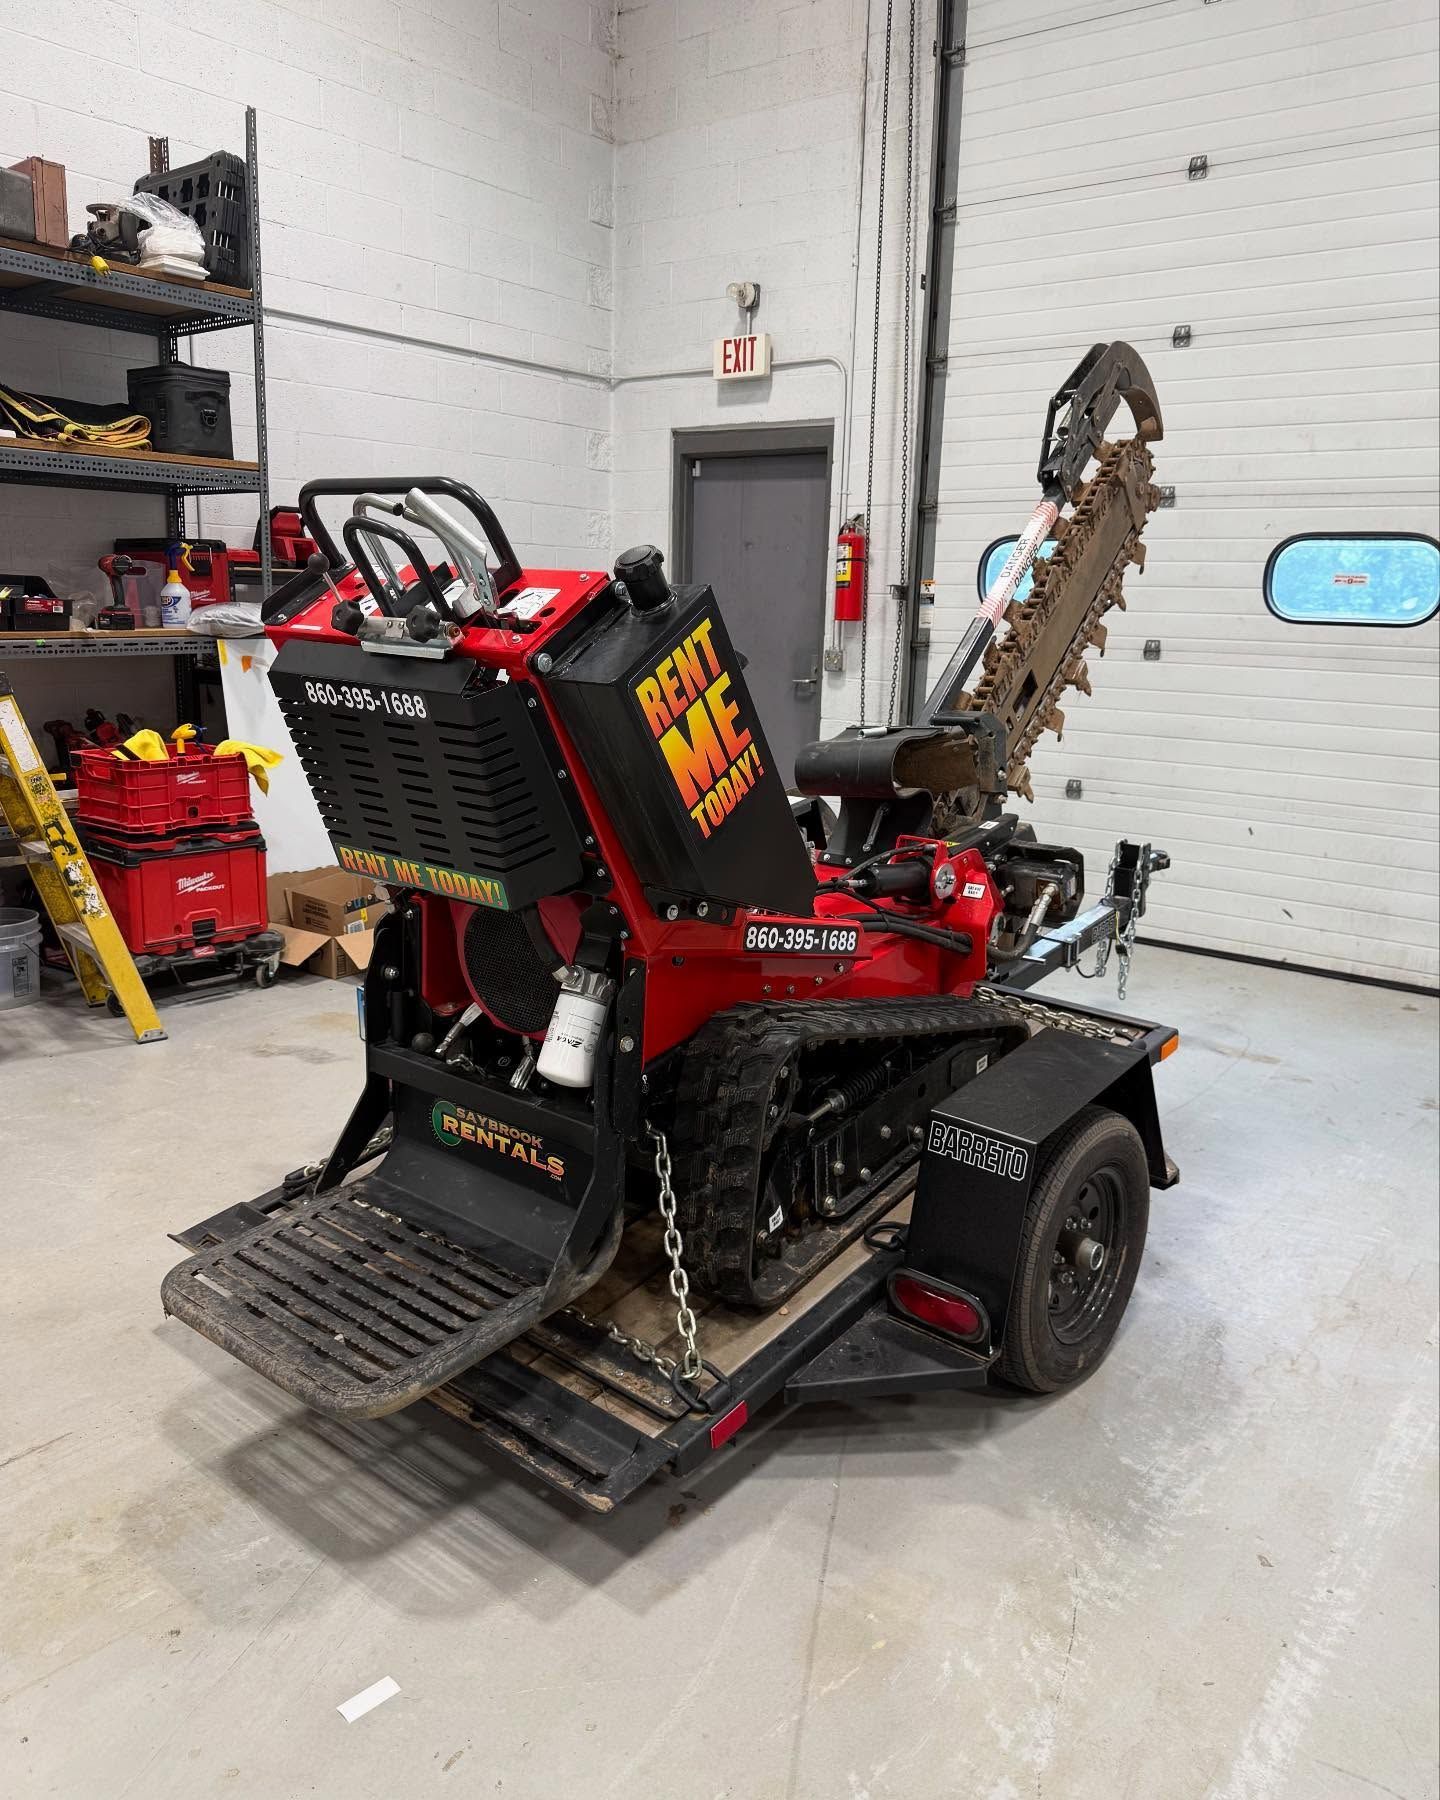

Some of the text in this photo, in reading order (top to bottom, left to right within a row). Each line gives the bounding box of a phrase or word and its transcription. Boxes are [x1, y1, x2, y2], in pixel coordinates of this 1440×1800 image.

[723, 336, 757, 374] EXIT
[1000, 538, 1030, 578] DANGER
[305, 681, 427, 719] 860-395-1688
[635, 617, 721, 739] RENT
[658, 671, 752, 810] ME
[690, 742, 765, 840] TODAY!
[340, 847, 503, 907] RENT ME TODAY!
[746, 926, 857, 951] 860-395-1688
[442, 1114, 565, 1176] RENTALS
[456, 1107, 543, 1149] SAYBROOK
[927, 1120, 1029, 1181] BARRETO
